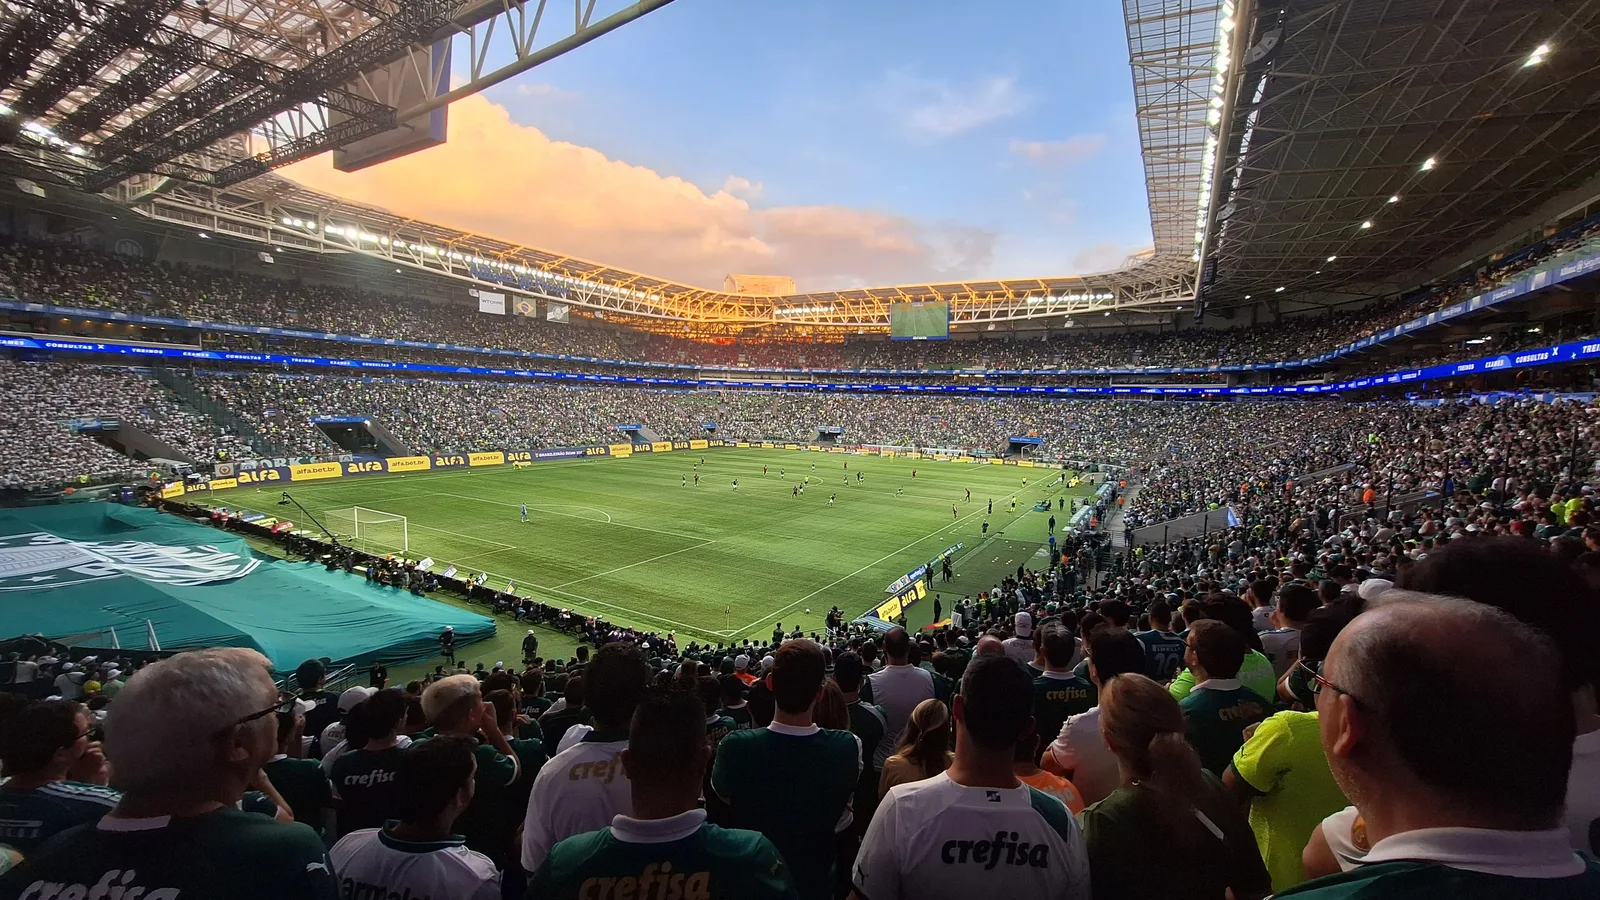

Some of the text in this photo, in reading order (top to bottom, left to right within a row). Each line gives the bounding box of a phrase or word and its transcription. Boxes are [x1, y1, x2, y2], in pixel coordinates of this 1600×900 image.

[46, 342, 92, 350] CONSULTAS
[1485, 359, 1504, 368] EXAMES
[1516, 352, 1549, 364] CONSULTAS
[586, 446, 606, 456] alfa
[634, 444, 650, 452] alfa
[436, 454, 500, 466] alfa alfa.bet.br
[508, 451, 532, 462] alfa
[348, 459, 424, 473] alfa alfa.bet.br
[238, 466, 336, 483] alfa alfa.bet.br
[187, 483, 206, 492] alfa
[901, 588, 917, 608] alfa
[1046, 686, 1088, 702] crefisa
[568, 752, 626, 784] cref
[940, 830, 1050, 870] crefisa
[578, 861, 711, 900] crefisa
